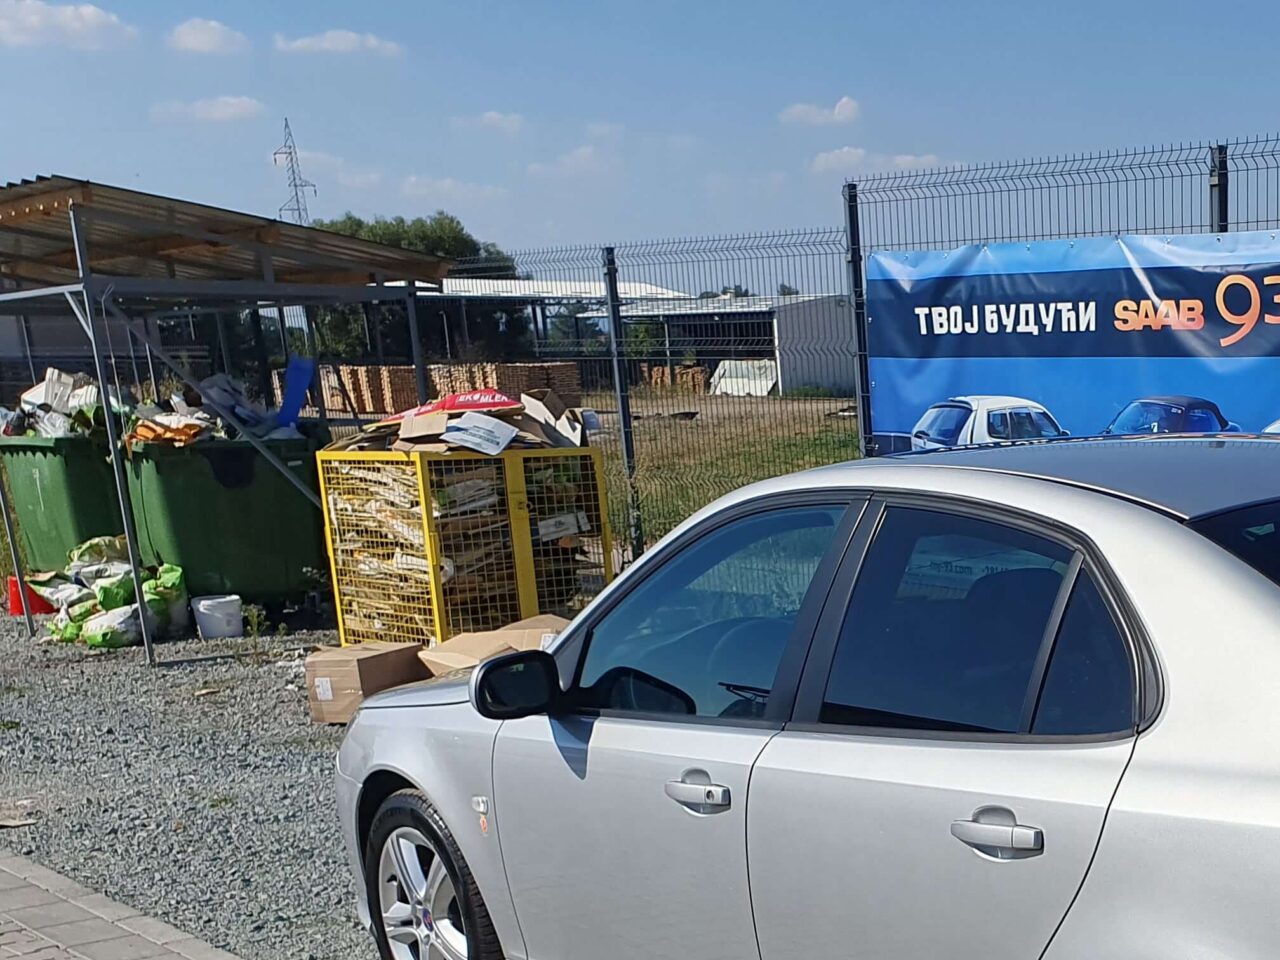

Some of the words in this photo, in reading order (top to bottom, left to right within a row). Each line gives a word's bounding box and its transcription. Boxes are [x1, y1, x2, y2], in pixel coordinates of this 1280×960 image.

[914, 304, 979, 335] ТВОЈ
[984, 301, 1097, 336] БУДУЋИ
[1113, 299, 1205, 331] SAAB
